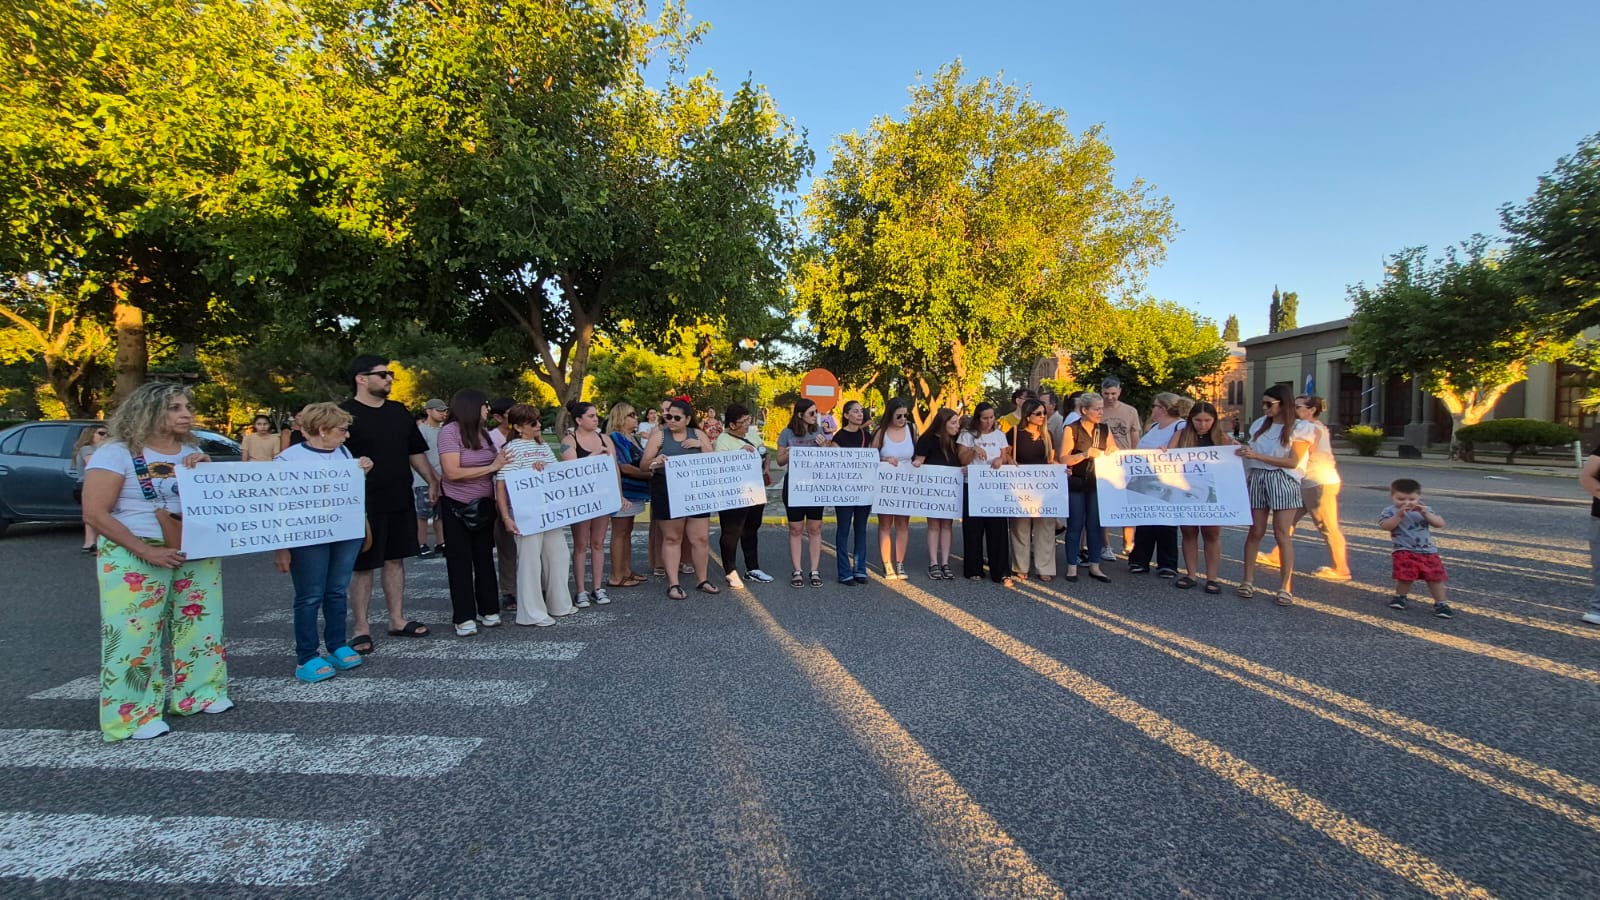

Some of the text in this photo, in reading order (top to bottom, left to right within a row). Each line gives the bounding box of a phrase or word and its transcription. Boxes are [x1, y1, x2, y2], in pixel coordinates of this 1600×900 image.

[669, 454, 758, 468] UNA MEDIDA JUDICIAL
[1188, 451, 1220, 462] POR
[194, 469, 351, 483] CUANDO A UN NIÑO/A
[515, 462, 609, 491] ¡SIN ESCUCHA
[676, 464, 752, 479] NO PUEDE BORRAR
[813, 472, 863, 481] DE LA JUEZA
[879, 472, 893, 480] NO
[896, 473, 915, 481] FUE
[1130, 464, 1207, 475] ISABELLA!
[137, 472, 157, 499] LOVE
[703, 476, 741, 487] DERECHO
[204, 483, 349, 500] LO ARRANCAN DE SU
[544, 482, 596, 503] NO HAY
[684, 494, 696, 502] DE
[698, 492, 715, 501] UNA
[881, 486, 957, 497] FUE VIOLENCIA
[187, 505, 246, 516] MUNDO
[251, 502, 274, 513] SIN
[540, 500, 602, 529] JUSTICIA!
[685, 504, 712, 513] SABER
[216, 522, 238, 533] NO
[242, 521, 257, 530] ES
[262, 519, 282, 529] UN
[231, 529, 334, 548] ES UNA HERIDA
